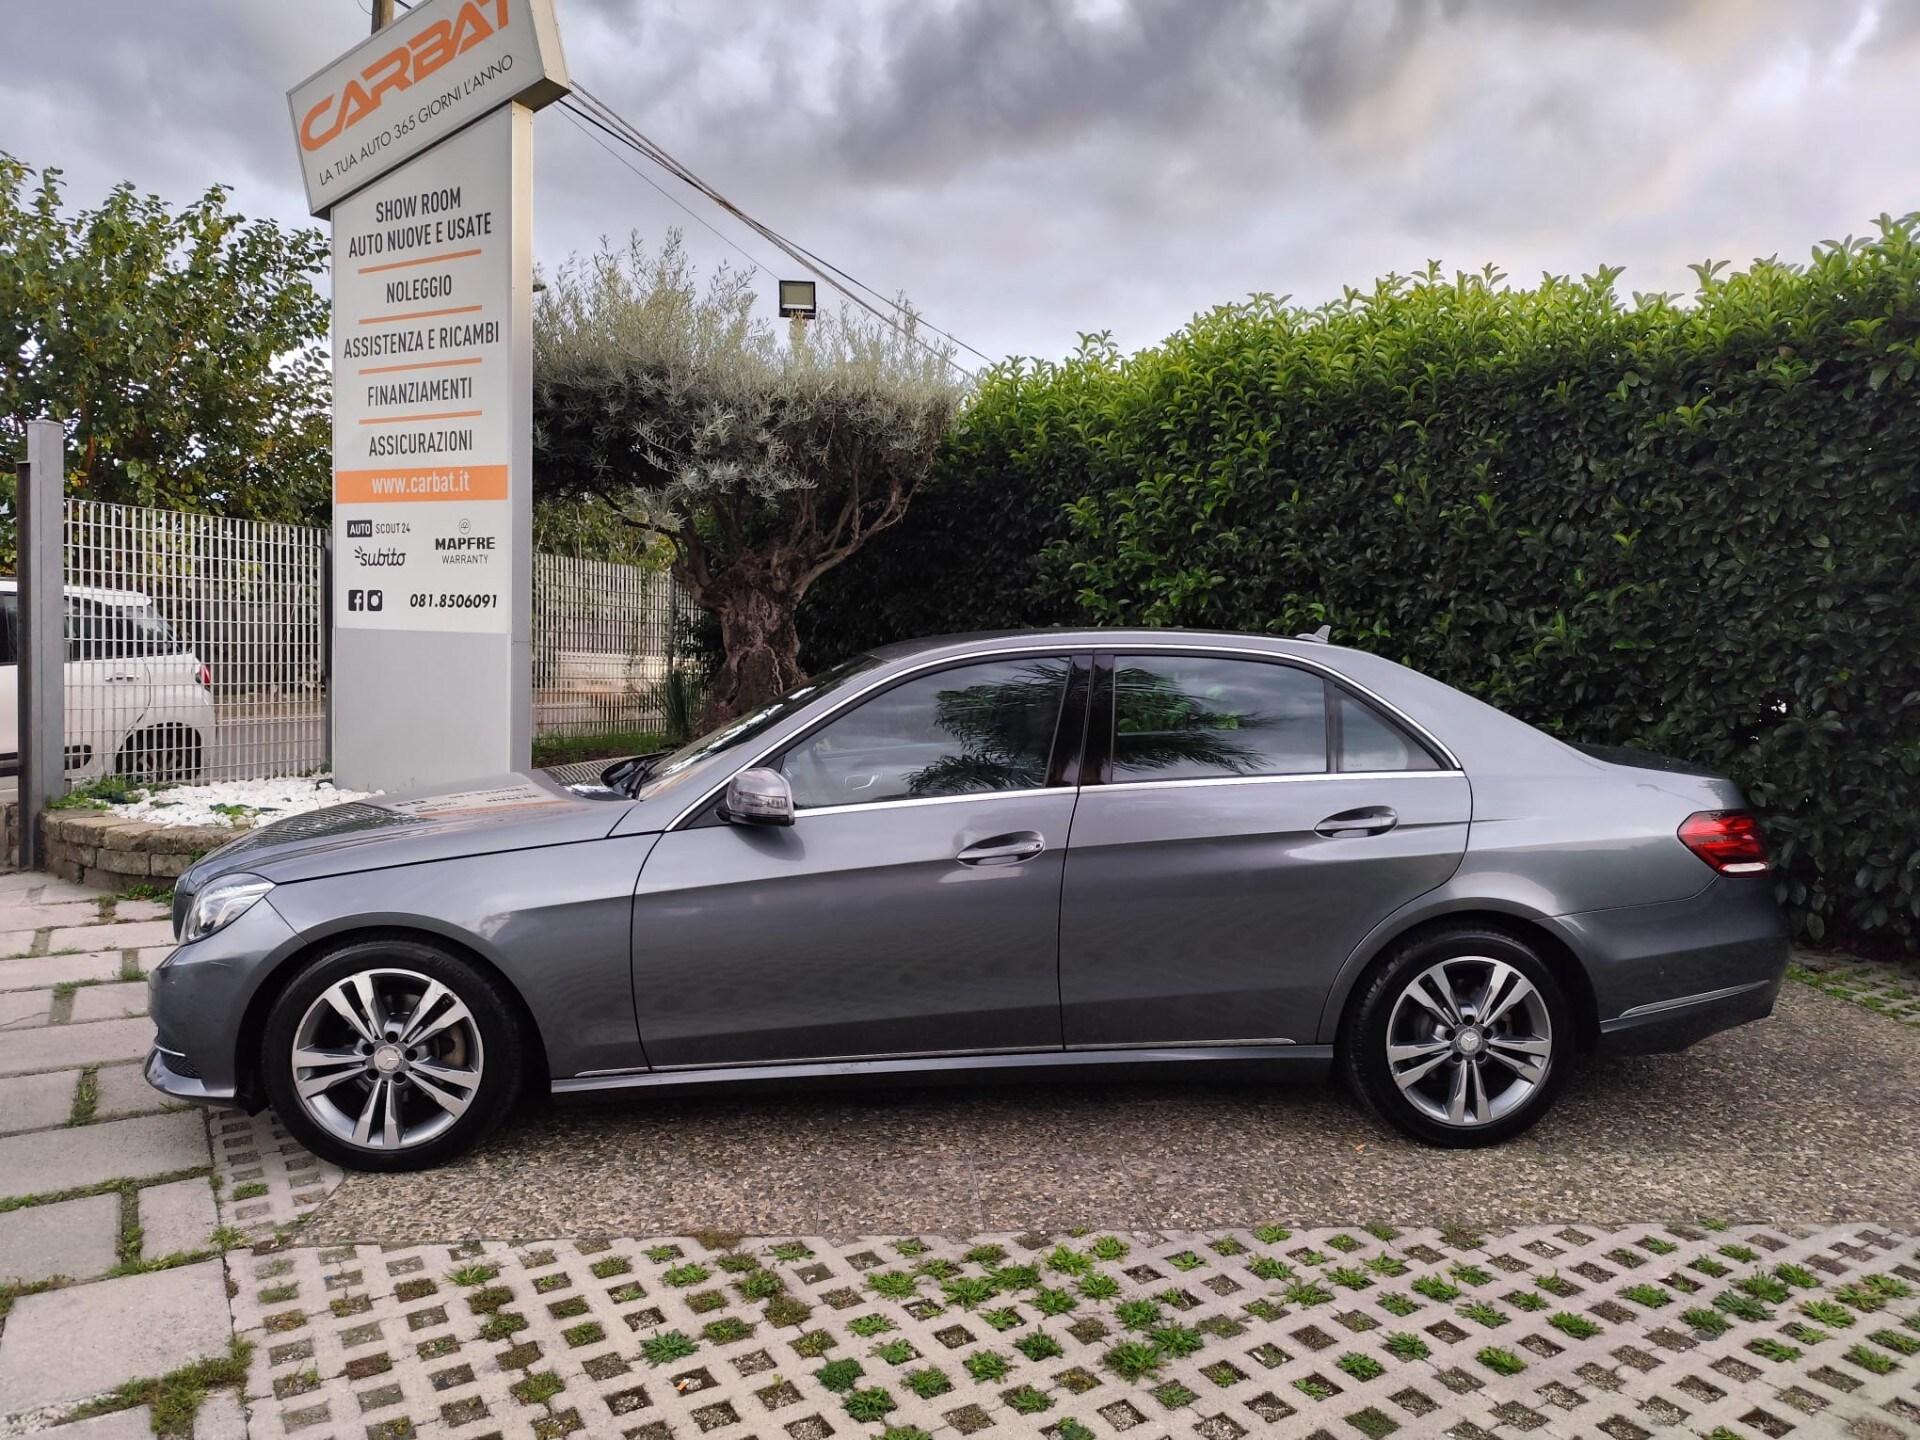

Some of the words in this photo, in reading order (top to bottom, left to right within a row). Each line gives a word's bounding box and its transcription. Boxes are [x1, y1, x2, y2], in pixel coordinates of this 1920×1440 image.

[319, 168, 334, 186] LA
[334, 153, 358, 176] TUA
[360, 131, 391, 160] AUTO
[393, 114, 415, 139] 365
[418, 86, 461, 123] GIORNI
[464, 54, 513, 95] L'ANNO
[376, 195, 417, 223] SHOW
[421, 186, 461, 215] ROOM
[348, 232, 383, 258] AUTO
[387, 223, 431, 252] NUOVE
[436, 221, 443, 243] E
[447, 212, 492, 241] USATE
[386, 274, 452, 304] NOLEGGIO
[344, 330, 424, 359] ASSISTENZA
[428, 329, 435, 350] E
[440, 321, 499, 349] RICAMBI
[367, 377, 472, 407] FINANZIAMENTI
[369, 429, 473, 457] ASSICURAZIONI
[371, 470, 470, 494] www.carbat.it
[350, 523, 371, 535] AUTO
[375, 522, 400, 534] SCOUT
[360, 547, 407, 566] subito
[435, 536, 496, 550] MAPFRE
[442, 554, 488, 564] WARRANTY
[410, 594, 497, 609] 081.8506091
